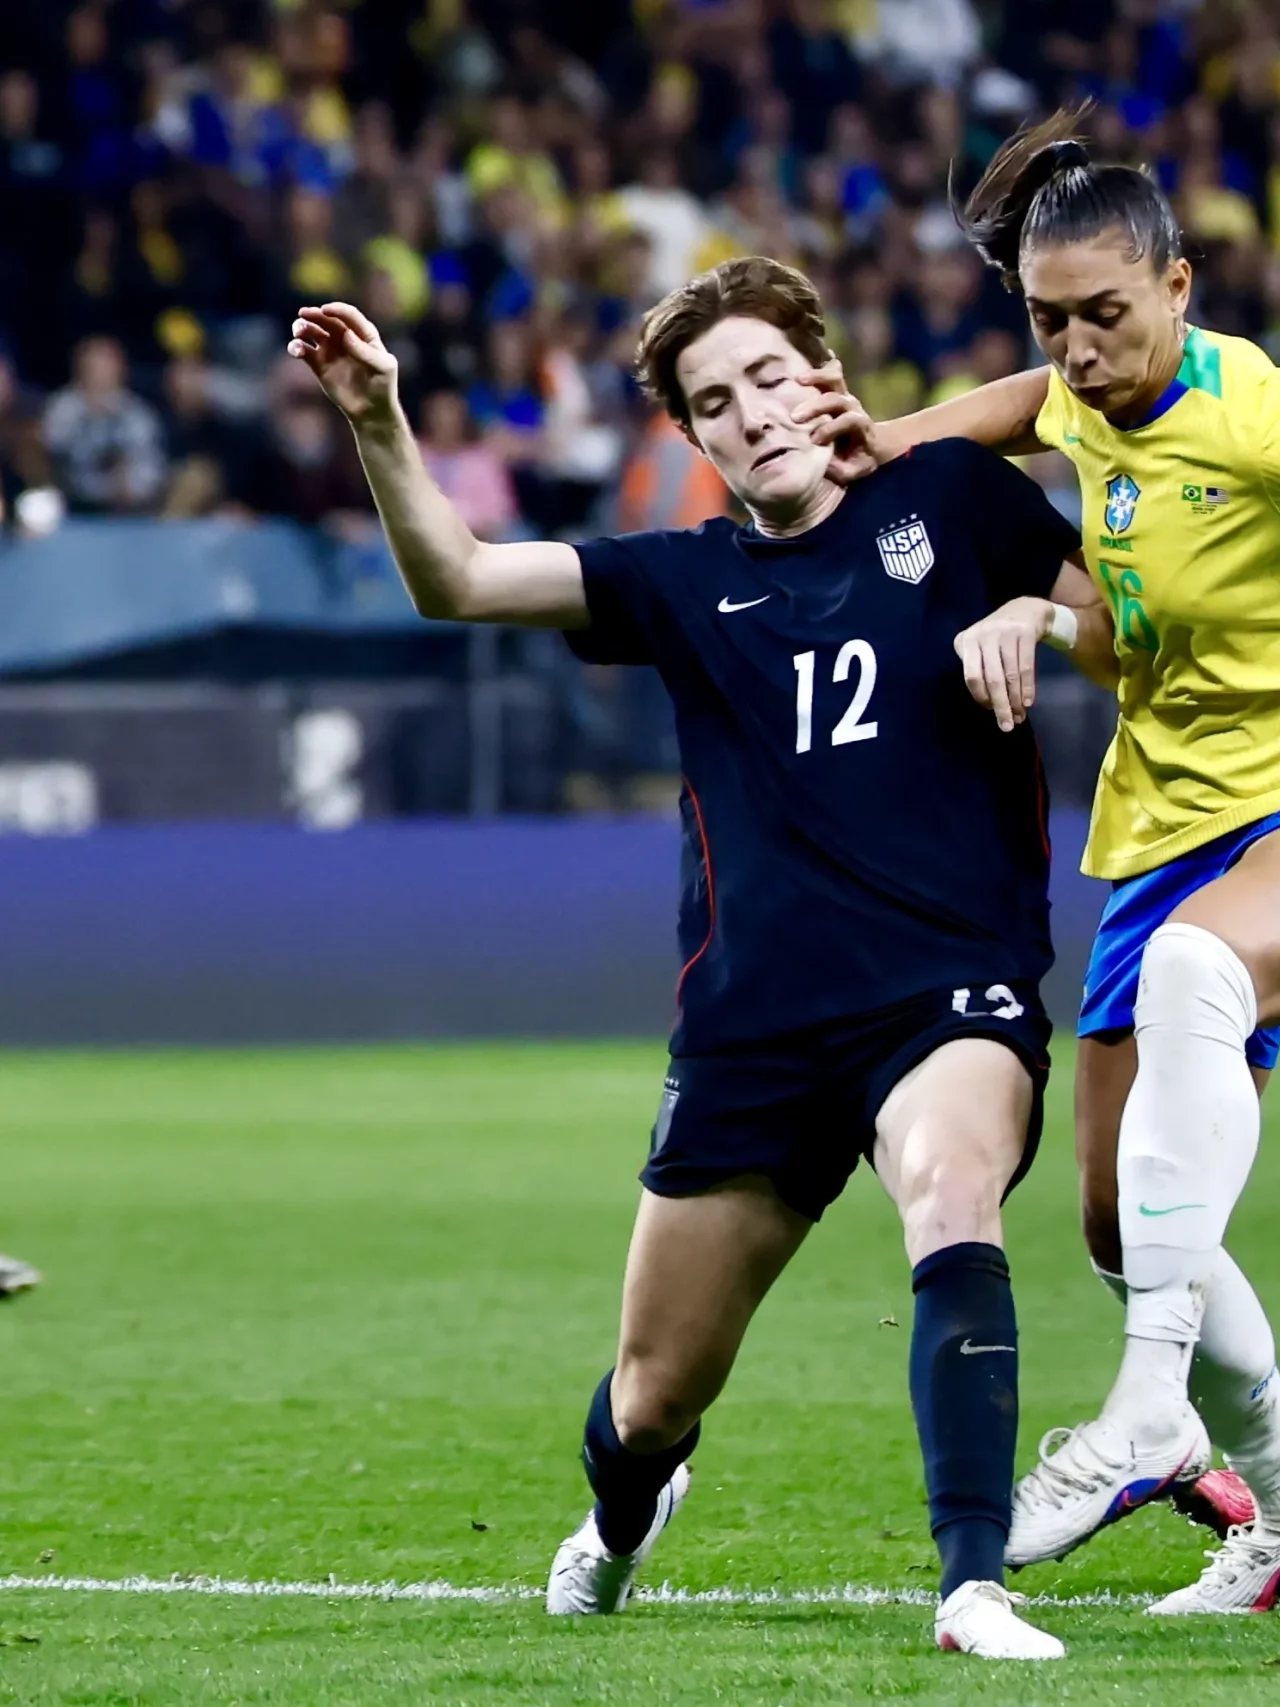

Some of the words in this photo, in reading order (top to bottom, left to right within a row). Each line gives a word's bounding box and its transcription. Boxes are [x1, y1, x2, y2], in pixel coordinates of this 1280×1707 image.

[881, 525, 923, 552] USA
[1101, 562, 1160, 651] 16
[793, 638, 878, 754] 12
